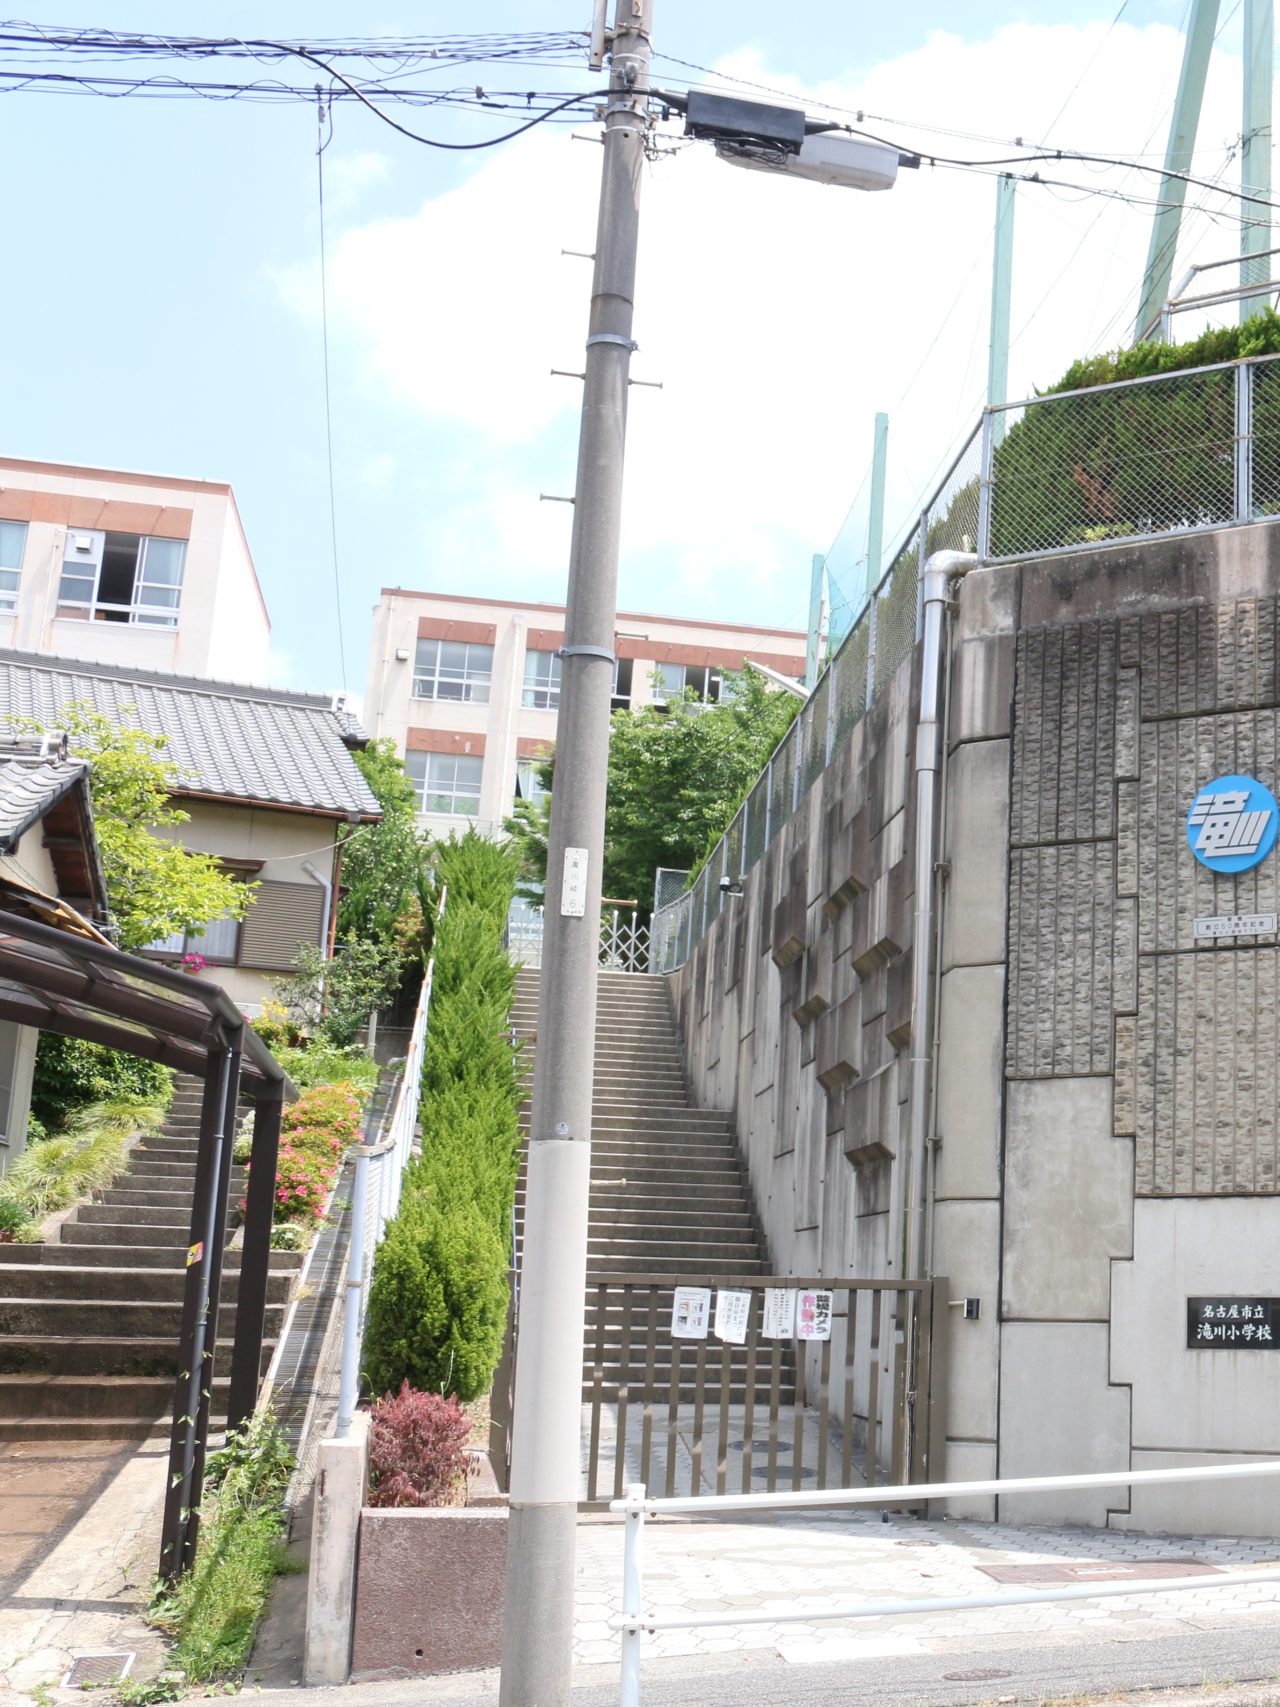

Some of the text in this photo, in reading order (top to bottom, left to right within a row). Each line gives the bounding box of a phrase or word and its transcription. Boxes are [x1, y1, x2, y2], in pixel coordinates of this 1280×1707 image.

[815, 1294, 830, 1334] 監視カメラ
[1202, 1304, 1264, 1320] 名古屋市立
[1196, 1322, 1273, 1341] 滝川小学校
